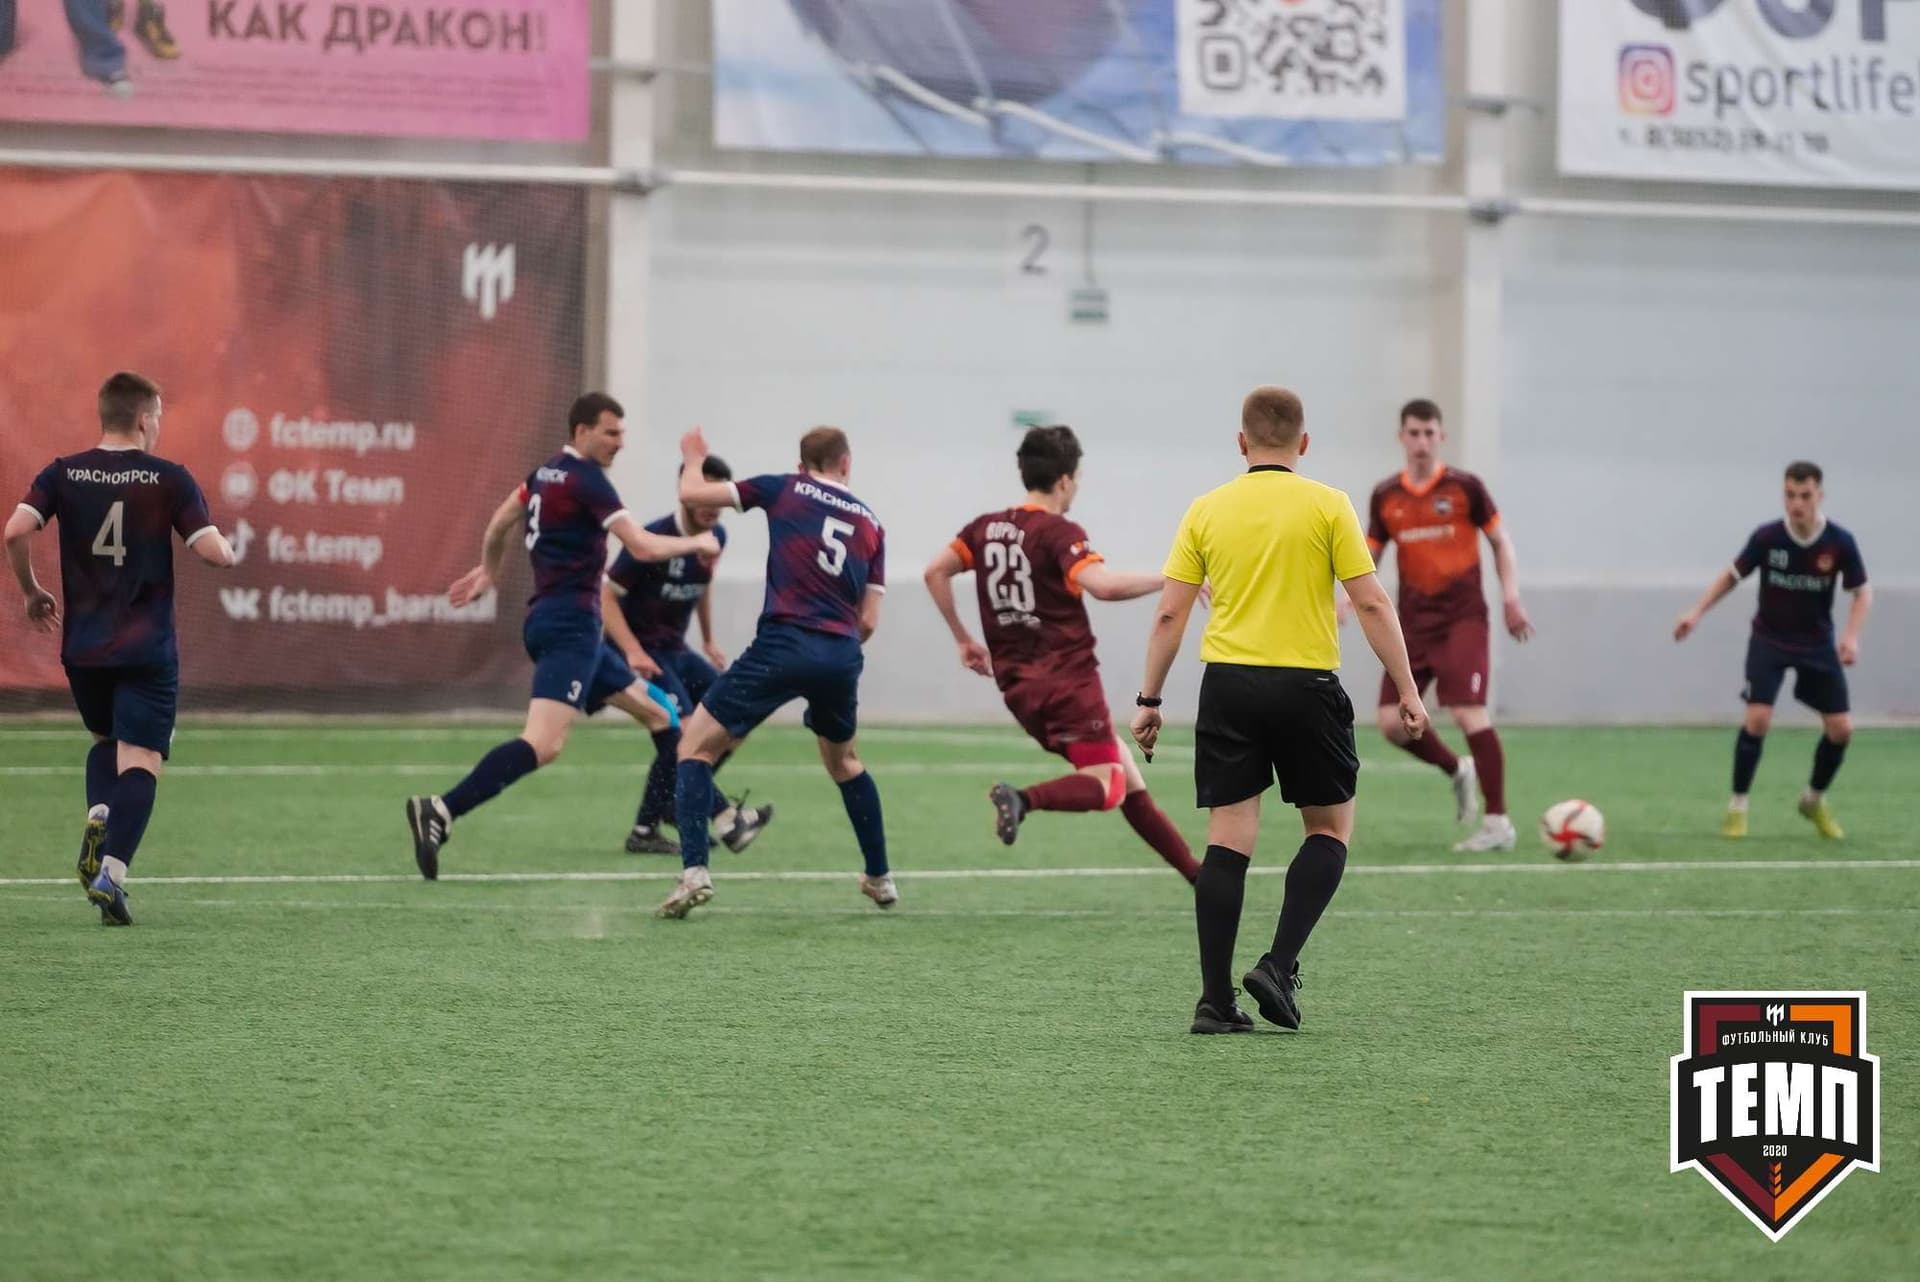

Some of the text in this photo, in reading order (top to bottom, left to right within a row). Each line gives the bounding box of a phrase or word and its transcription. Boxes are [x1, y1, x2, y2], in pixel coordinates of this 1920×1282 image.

[208, 4, 546, 52] КАК ДРАКОН!
[1685, 52, 1920, 119] sportlife
[1020, 224, 1050, 274] 2
[269, 413, 416, 456] fctemp.ru
[66, 468, 160, 485] КРАСНОЯРСК
[268, 468, 405, 504] ФК Темп
[92, 500, 127, 566] 4
[525, 494, 541, 549] 3
[817, 516, 855, 576] 5
[267, 527, 383, 570] fc.temp
[984, 542, 1036, 612] 23
[567, 680, 582, 701] 3
